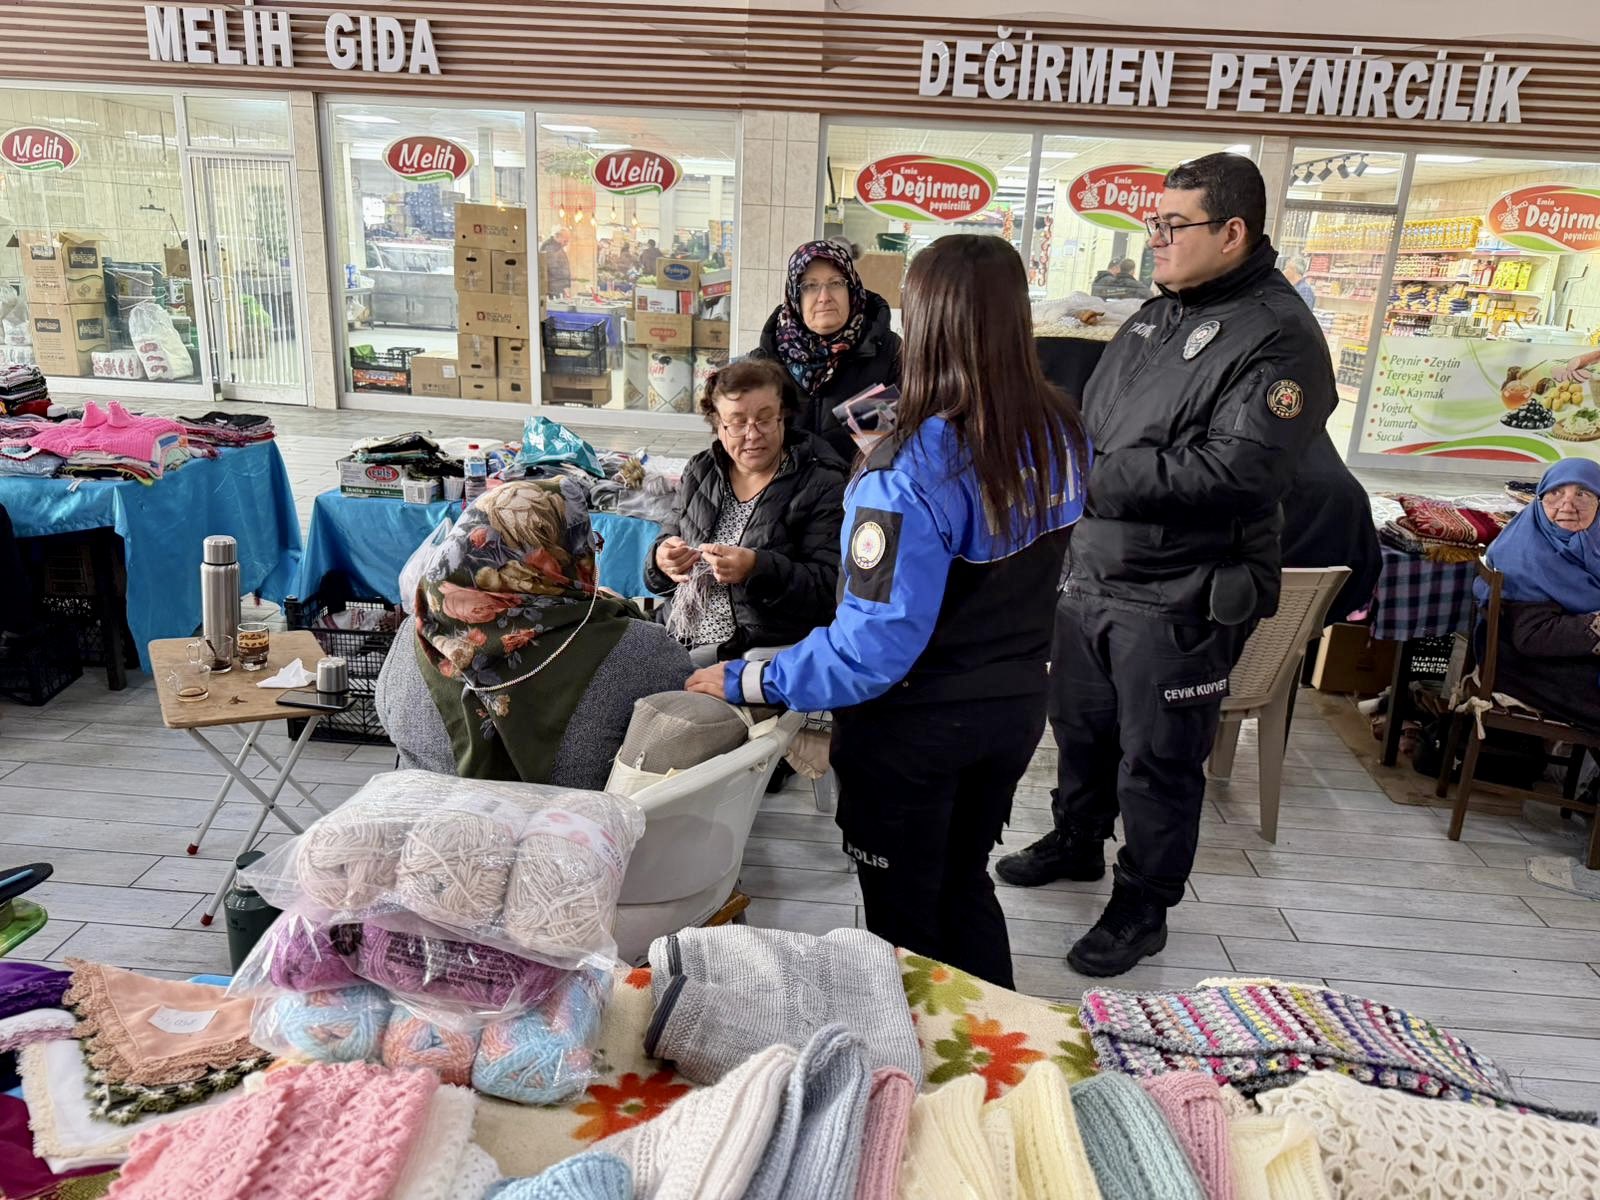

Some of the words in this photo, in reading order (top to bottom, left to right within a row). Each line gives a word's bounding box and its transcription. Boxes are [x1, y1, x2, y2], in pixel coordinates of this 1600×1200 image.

[324, 12, 442, 75] GIDA
[919, 25, 1174, 108] DEĞİRMEN
[1205, 45, 1532, 124] PEYNİRCİLİK
[12, 135, 63, 159] Melih
[398, 143, 455, 170] Melih
[605, 157, 664, 183] Melih
[900, 166, 918, 175] Emin
[891, 173, 980, 204] Değirmen
[1114, 176, 1133, 185] Emin
[929, 200, 972, 212] peynircilik
[1103, 182, 1164, 214] Değir
[1536, 197, 1555, 206] Emin
[1525, 204, 1600, 235] Değirme
[1389, 355, 1422, 368] Peynir
[1429, 357, 1461, 371] Zeytin
[1386, 370, 1424, 384] Tereyağ
[1434, 372, 1452, 383] Lor
[1383, 386, 1399, 397] Bal
[1407, 387, 1445, 400] Kaymak
[1380, 402, 1413, 416] Yoğurt
[1378, 416, 1418, 429] Yumurta
[1375, 431, 1404, 442] Sucuk
[1164, 686, 1196, 702] ÇEVİK
